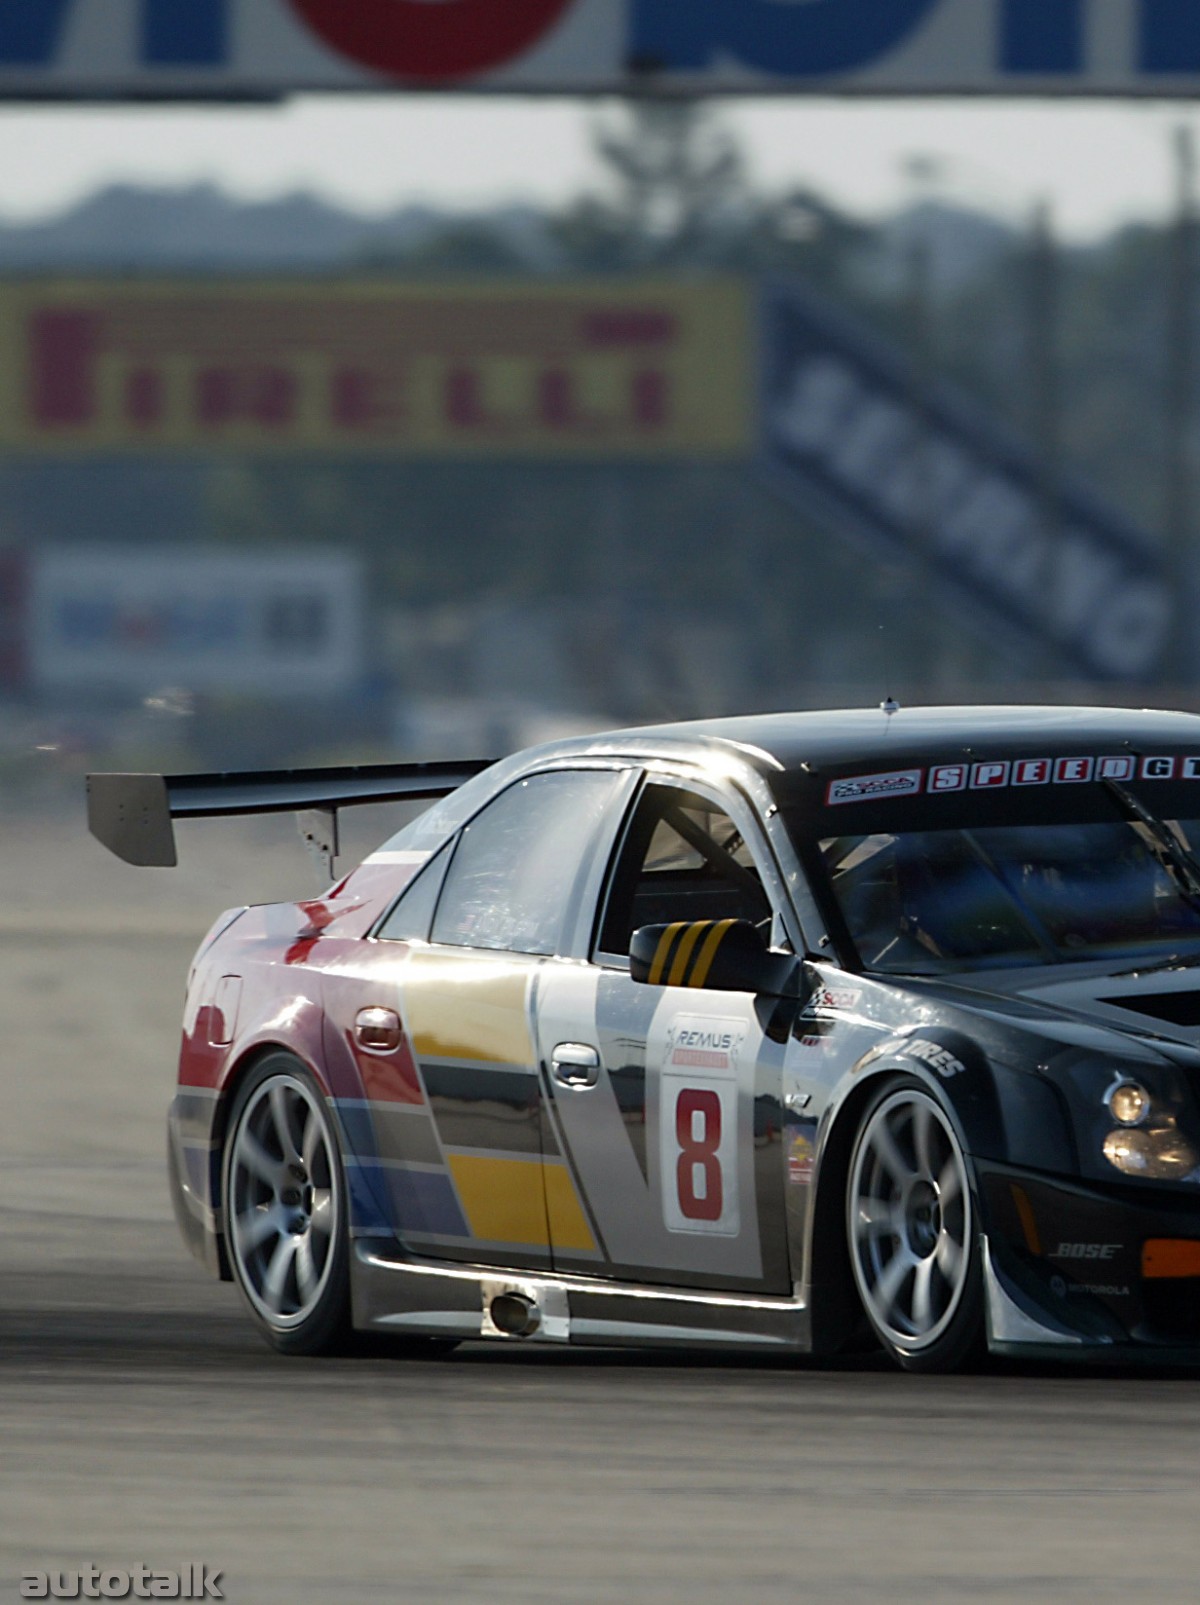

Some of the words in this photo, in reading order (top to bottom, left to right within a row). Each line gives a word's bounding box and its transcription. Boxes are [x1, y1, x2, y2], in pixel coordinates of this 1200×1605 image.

[28, 302, 676, 434] PIRELLI
[933, 758, 1129, 789] SPEED
[677, 1030, 731, 1048] REMUS
[676, 1088, 723, 1221] 8
[1048, 1243, 1123, 1259] BOSE
